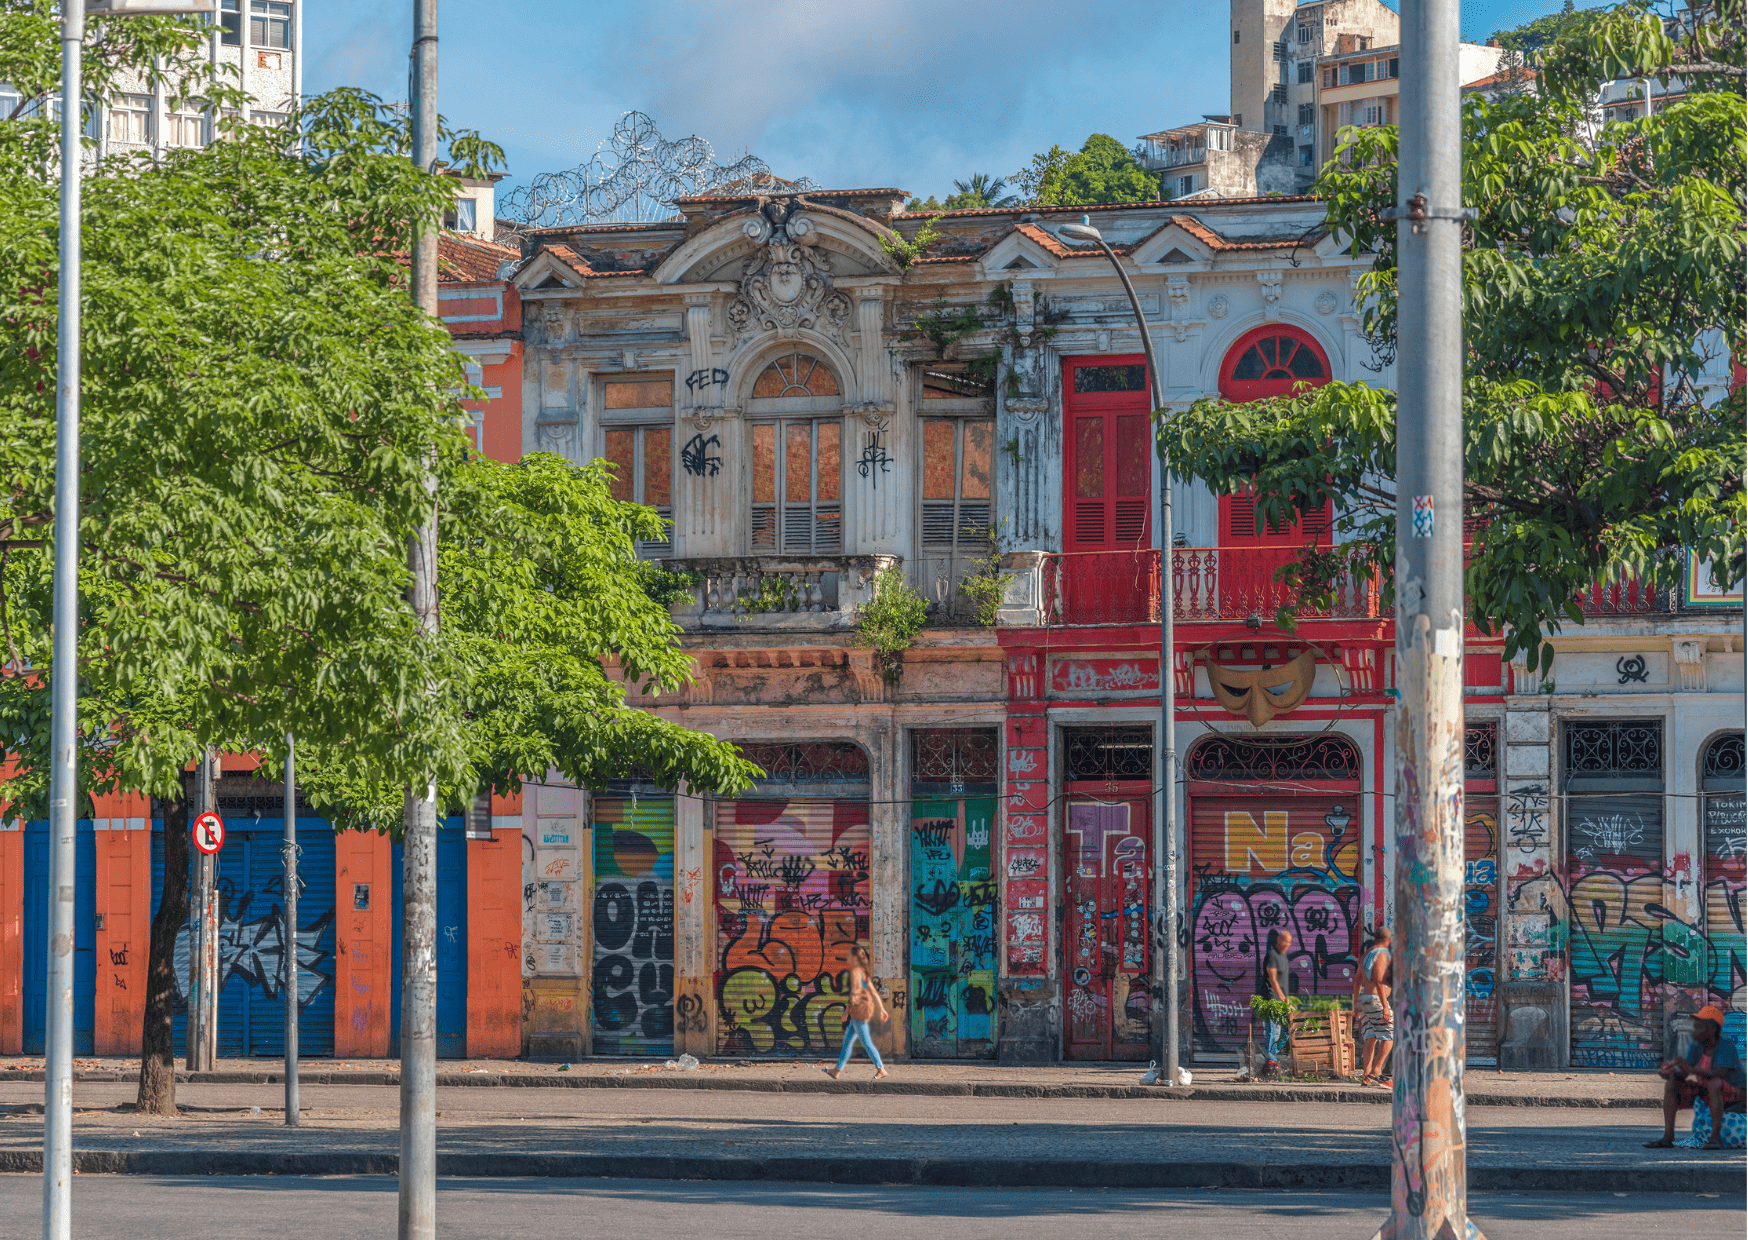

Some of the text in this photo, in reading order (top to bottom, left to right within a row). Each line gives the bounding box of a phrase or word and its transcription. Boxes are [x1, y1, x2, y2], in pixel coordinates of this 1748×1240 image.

[952, 784, 964, 792] 33
[1105, 782, 1119, 793] 35
[205, 821, 215, 845] E
[1224, 810, 1327, 872] Na
